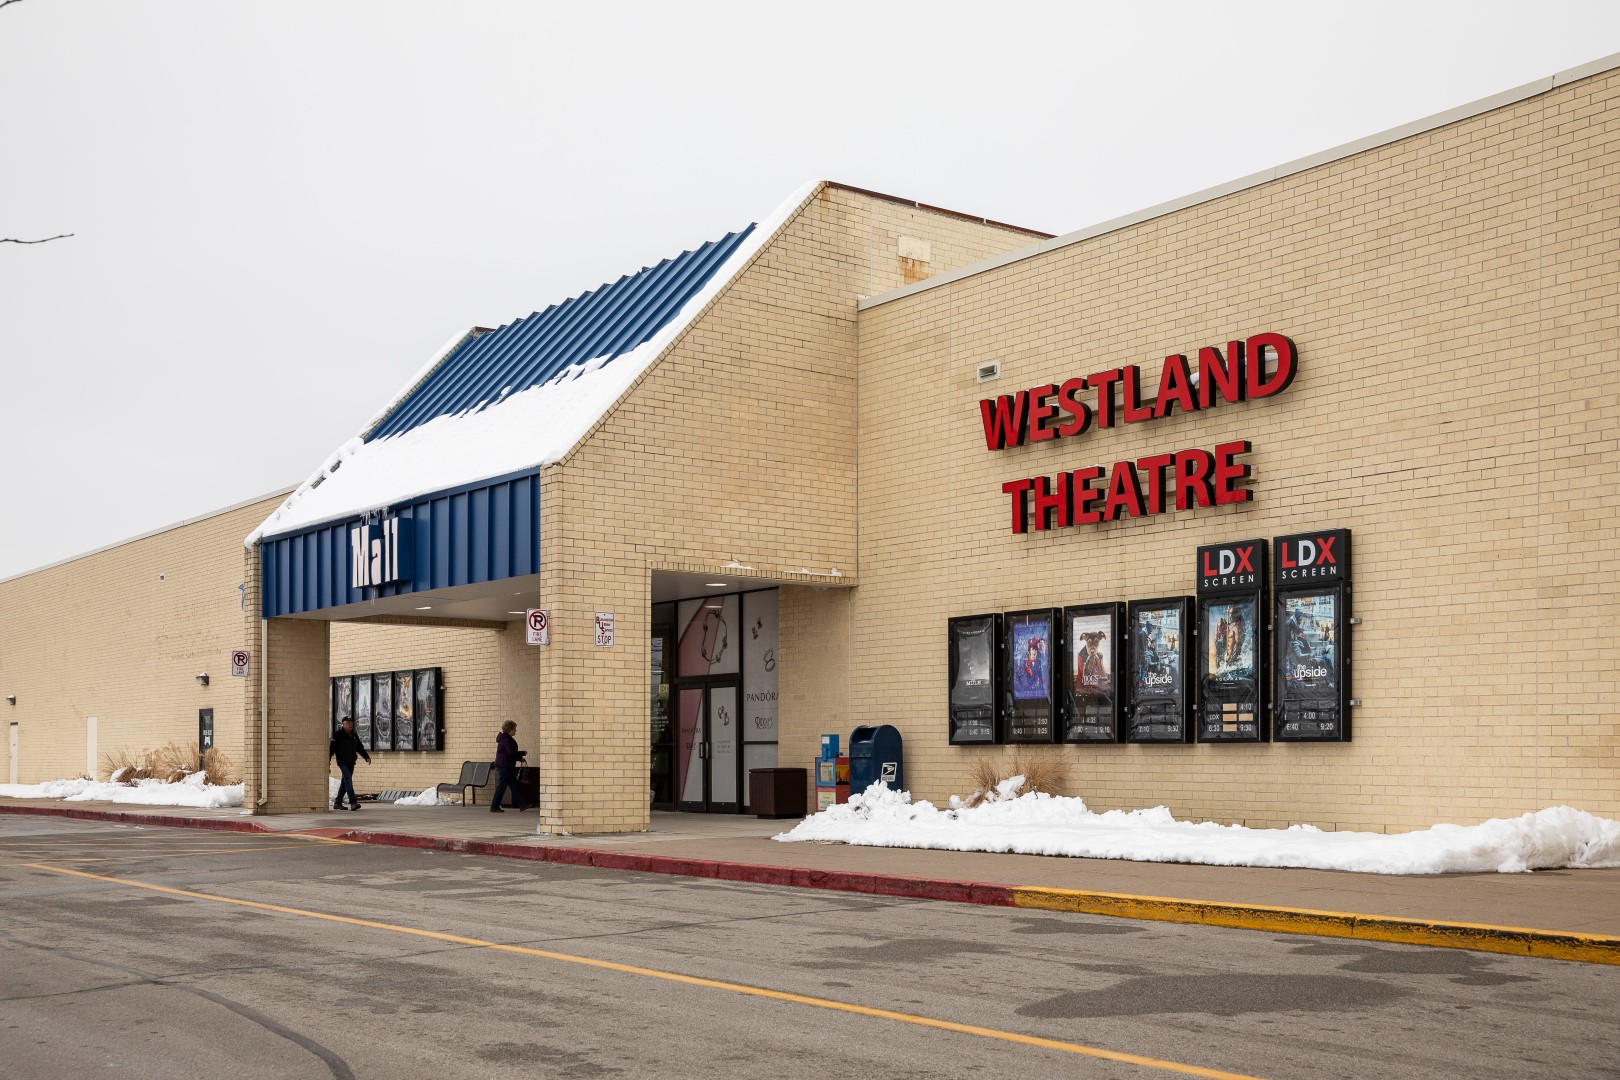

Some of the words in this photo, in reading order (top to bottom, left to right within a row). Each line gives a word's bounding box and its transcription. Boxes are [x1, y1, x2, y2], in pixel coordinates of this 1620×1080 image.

[979, 332, 1297, 450] WESTLAND
[1002, 440, 1252, 534] THEATRE
[351, 517, 398, 588] Mall
[1281, 536, 1336, 568] LDX
[1204, 546, 1254, 577] LDX
[1204, 574, 1254, 587] SCREEN
[1281, 566, 1337, 580] SCREEN
[597, 635, 611, 644] STOP
[1145, 672, 1172, 686] upside
[1294, 665, 1327, 680] upside
[1303, 711, 1316, 720] 4:00
